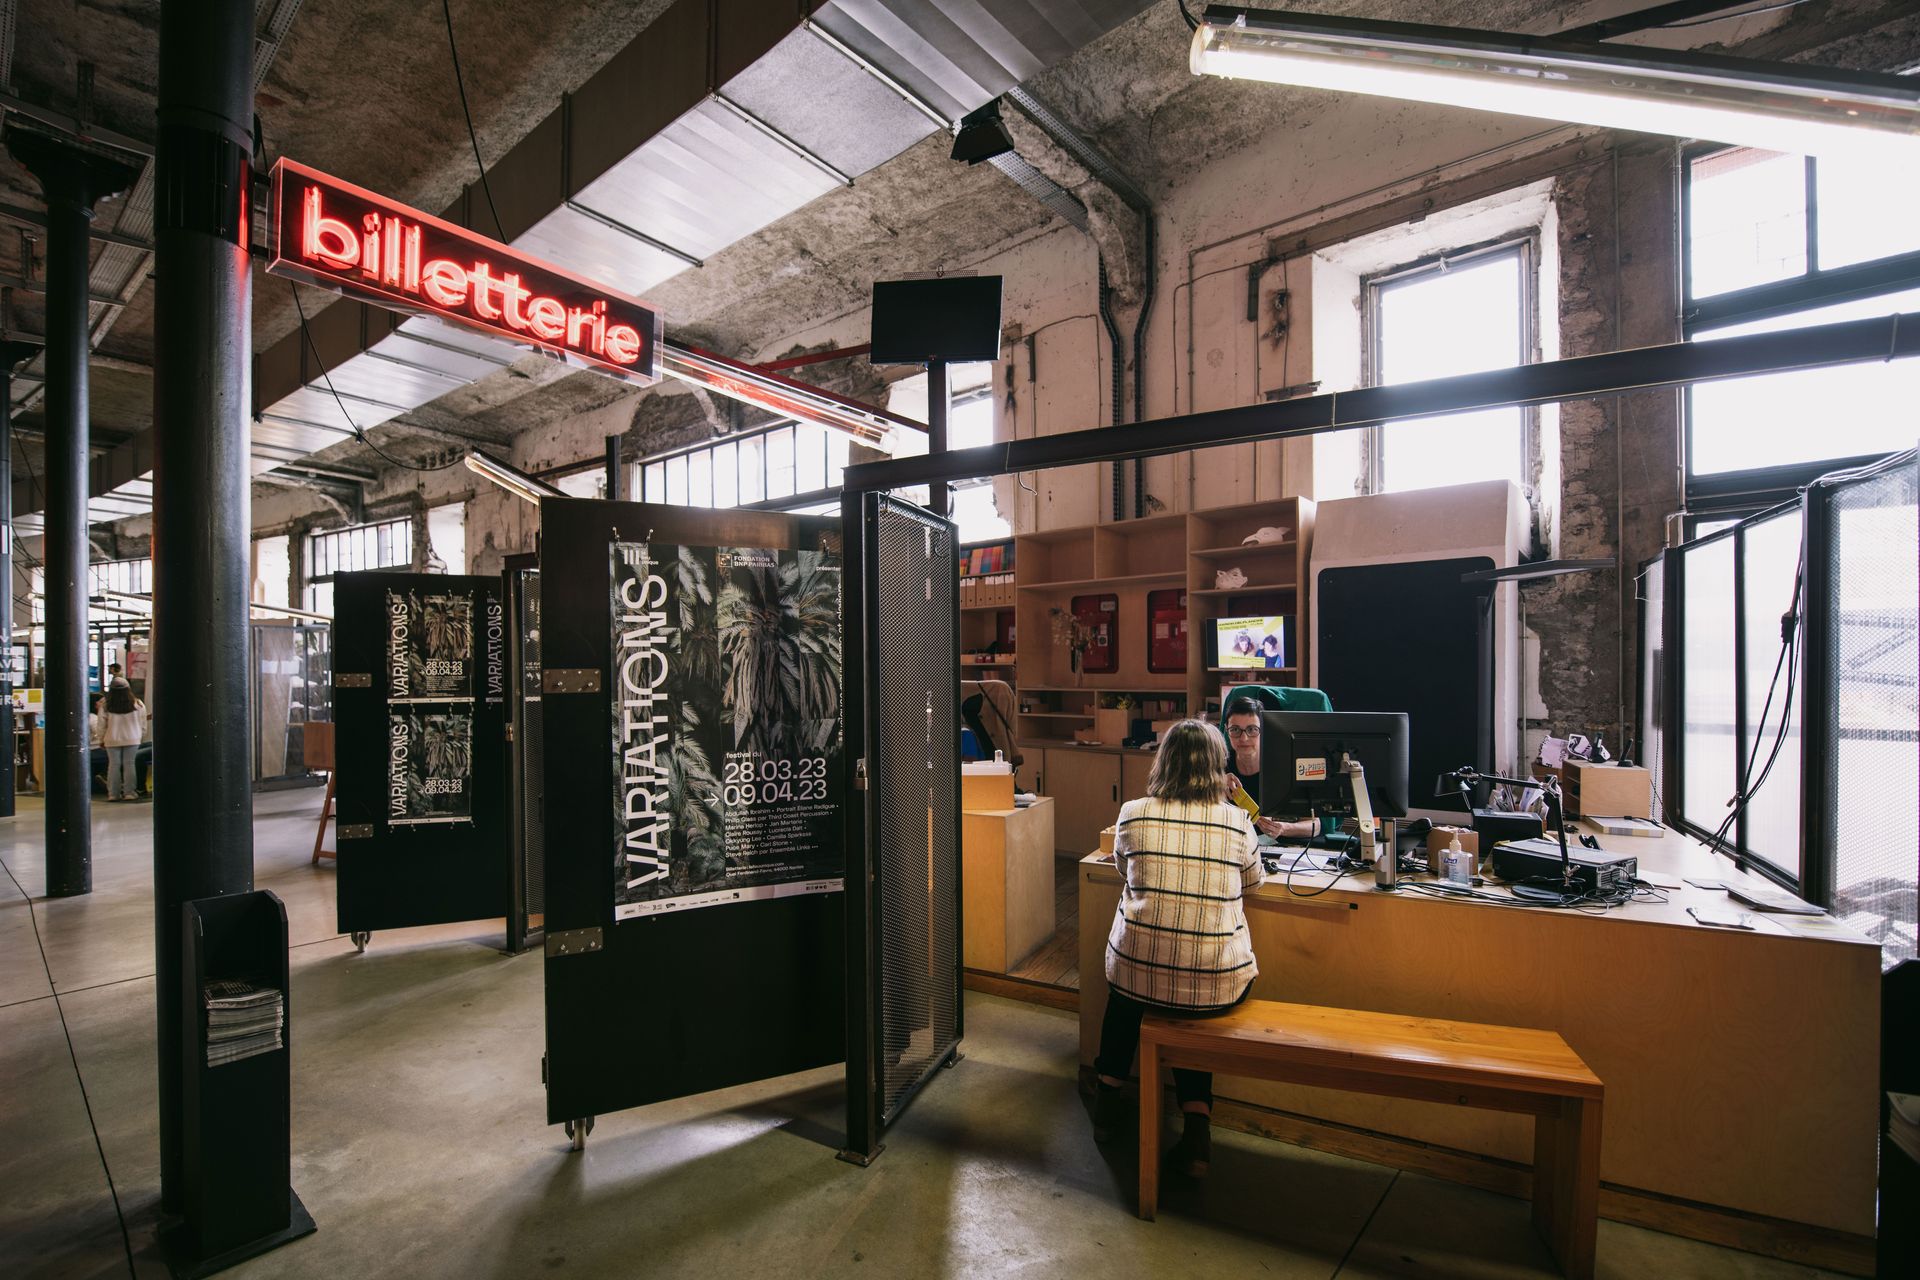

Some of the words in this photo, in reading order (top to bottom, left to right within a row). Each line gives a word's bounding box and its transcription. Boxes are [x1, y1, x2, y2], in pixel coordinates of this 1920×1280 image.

[303, 185, 641, 364] billetterie
[392, 602, 409, 697] VARIATIONS
[487, 604, 502, 695] VARIATIONS
[425, 668, 463, 676] 09.04.23
[426, 661, 463, 669] 28.03.23
[621, 574, 670, 889] VARIATIONS
[726, 751, 750, 759] festival
[391, 724, 409, 817] VARIATIONS
[425, 779, 462, 787] 28.03.23
[724, 757, 827, 784] 28.03.23
[424, 786, 462, 794] 09.04.23
[723, 779, 828, 806] 09.04.23
